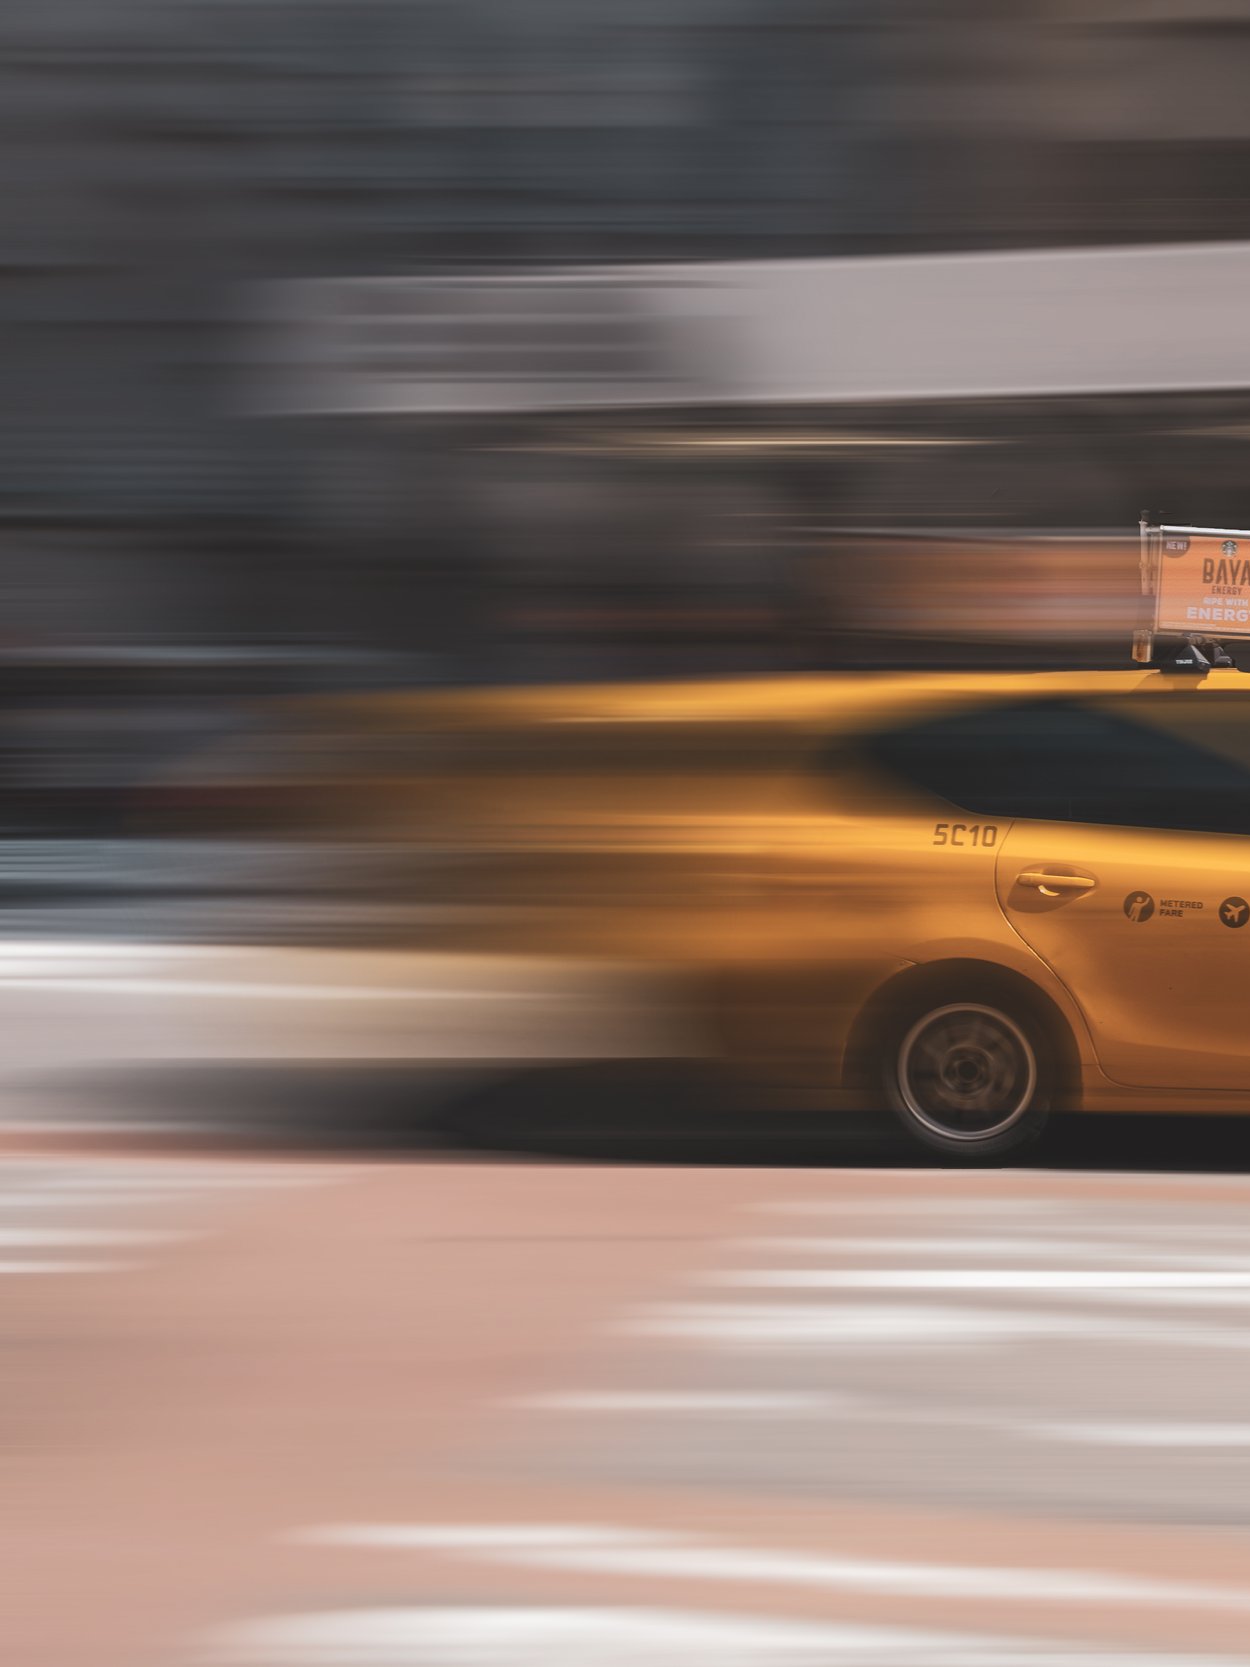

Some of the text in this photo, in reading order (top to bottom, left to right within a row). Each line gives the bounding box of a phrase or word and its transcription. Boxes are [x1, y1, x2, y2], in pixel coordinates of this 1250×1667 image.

[1166, 541, 1188, 551] NEW!
[1212, 585, 1243, 596] ENERGY
[1203, 597, 1249, 607] RIPE WITH
[933, 823, 998, 847] 5C10
[1160, 899, 1204, 910] METERED
[1159, 909, 1184, 918] FARE
